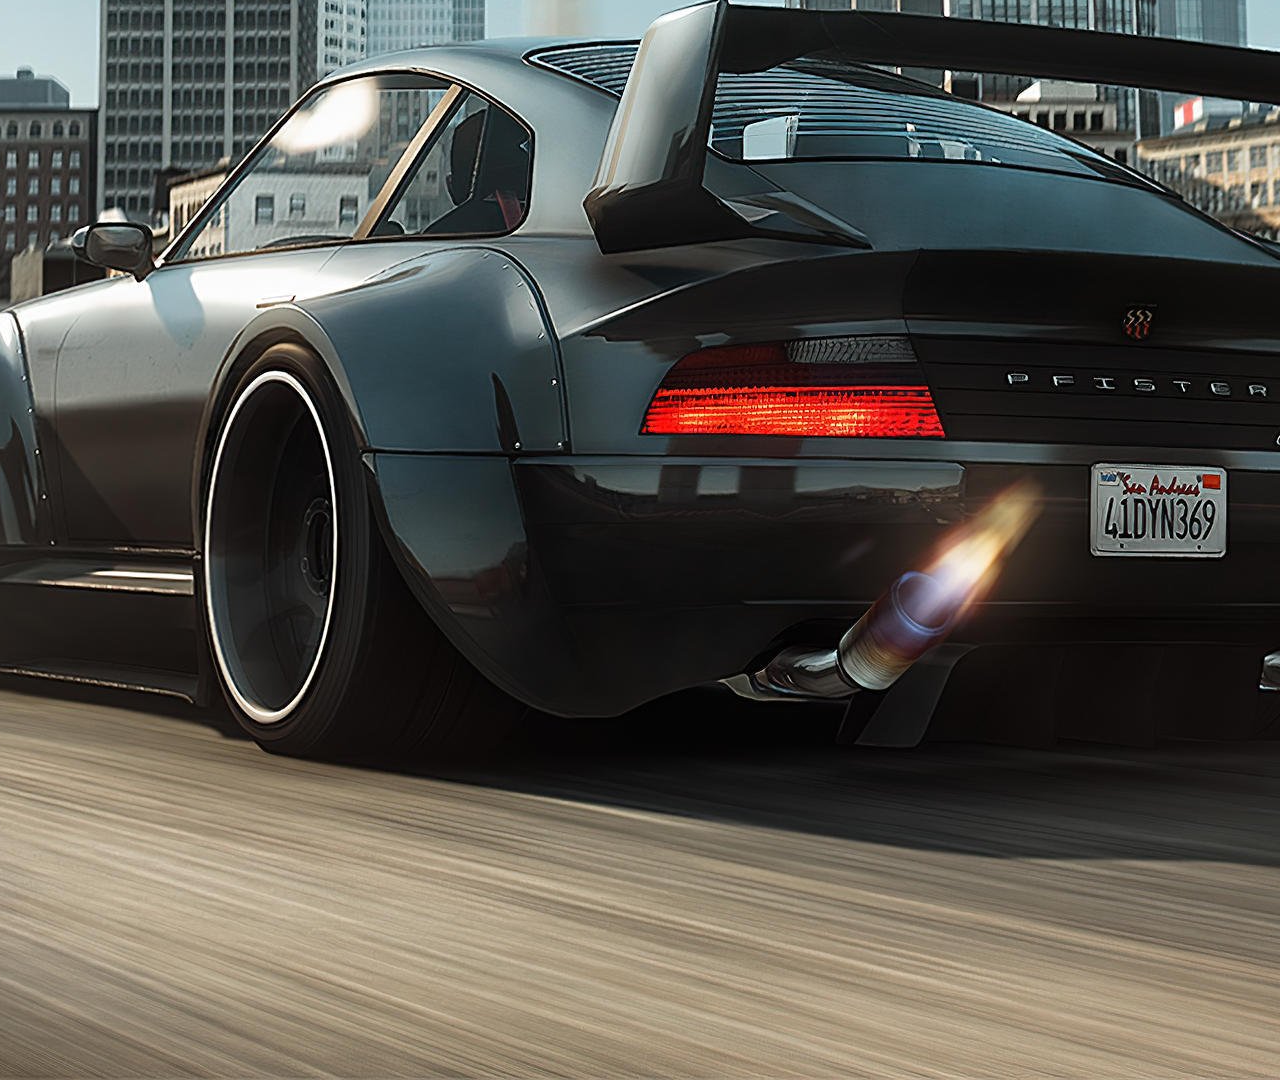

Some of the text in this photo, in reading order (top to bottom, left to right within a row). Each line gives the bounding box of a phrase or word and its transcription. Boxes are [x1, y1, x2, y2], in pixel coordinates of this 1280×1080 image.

[1006, 372, 1268, 398] PFISTER
[1148, 474, 1201, 497] Andreas
[1104, 496, 1217, 541] 41DYN369
